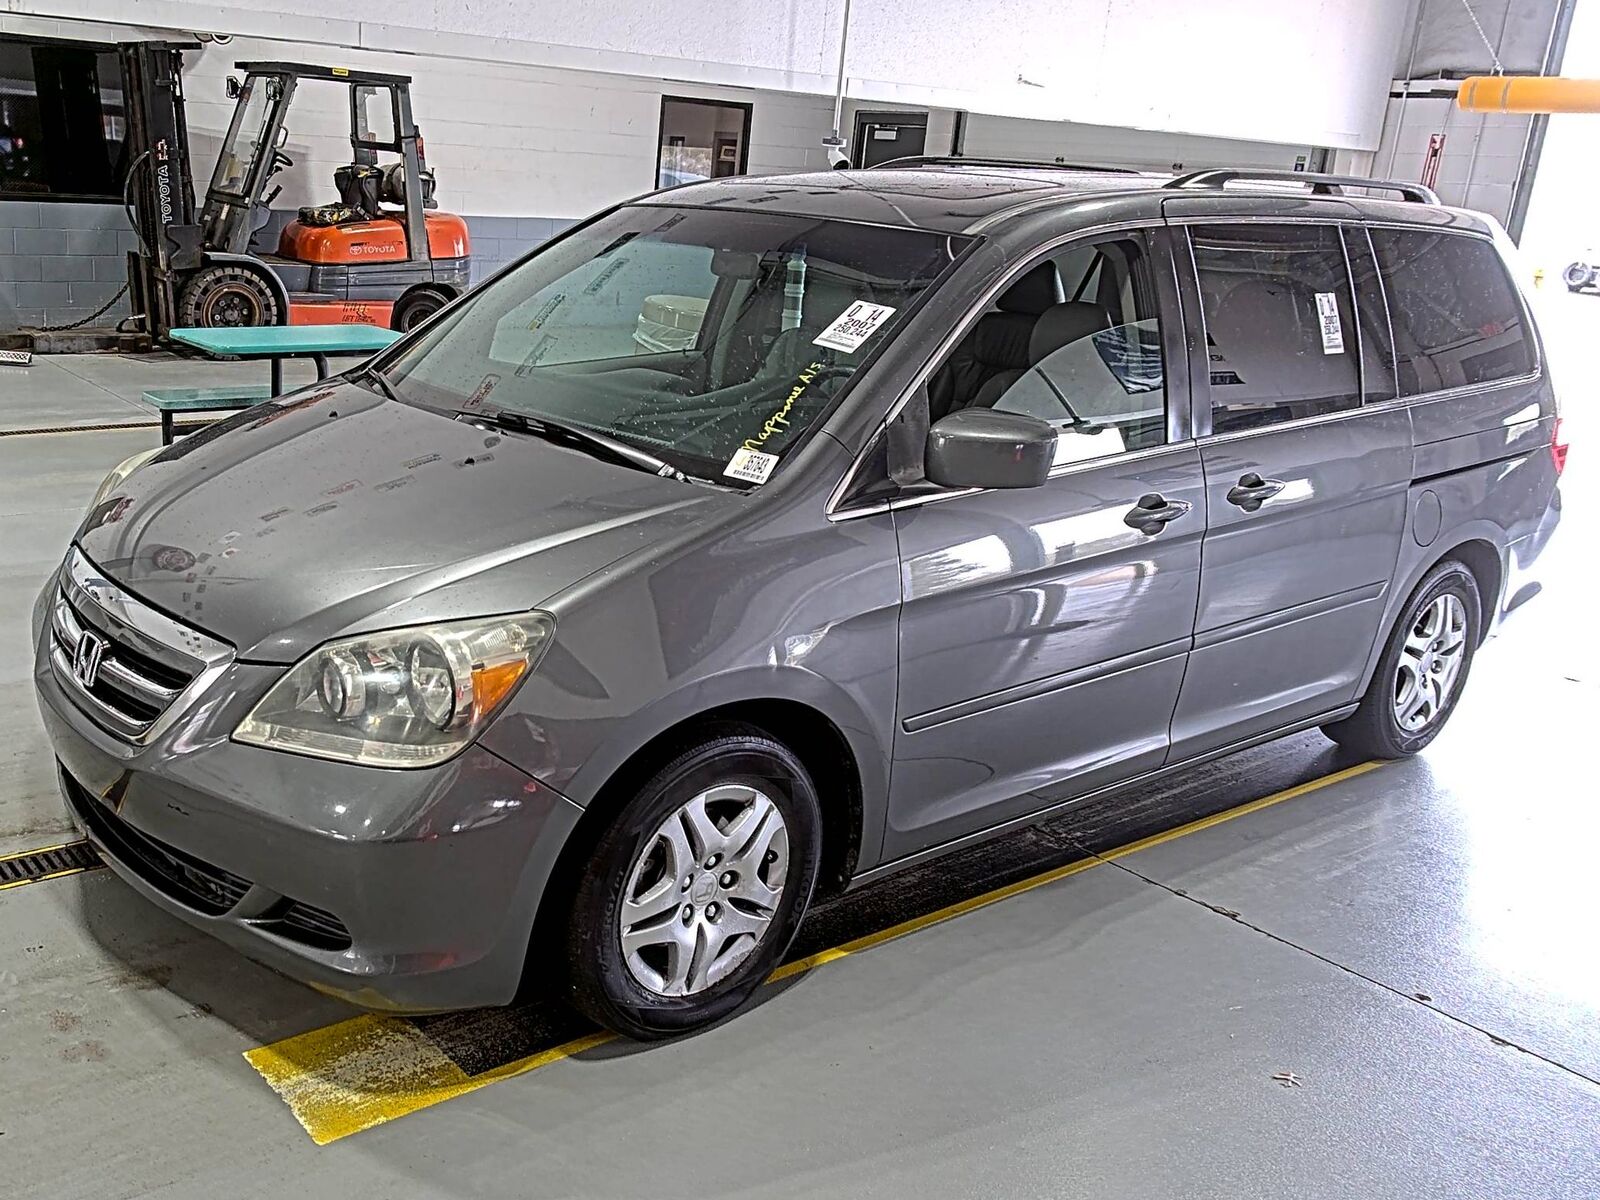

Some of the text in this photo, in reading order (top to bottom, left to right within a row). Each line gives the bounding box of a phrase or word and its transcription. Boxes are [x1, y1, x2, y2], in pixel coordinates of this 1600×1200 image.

[158, 165, 173, 224] TOYOTA
[364, 245, 396, 254] TOYOTA
[865, 308, 886, 323] 14
[844, 317, 876, 331] 2007
